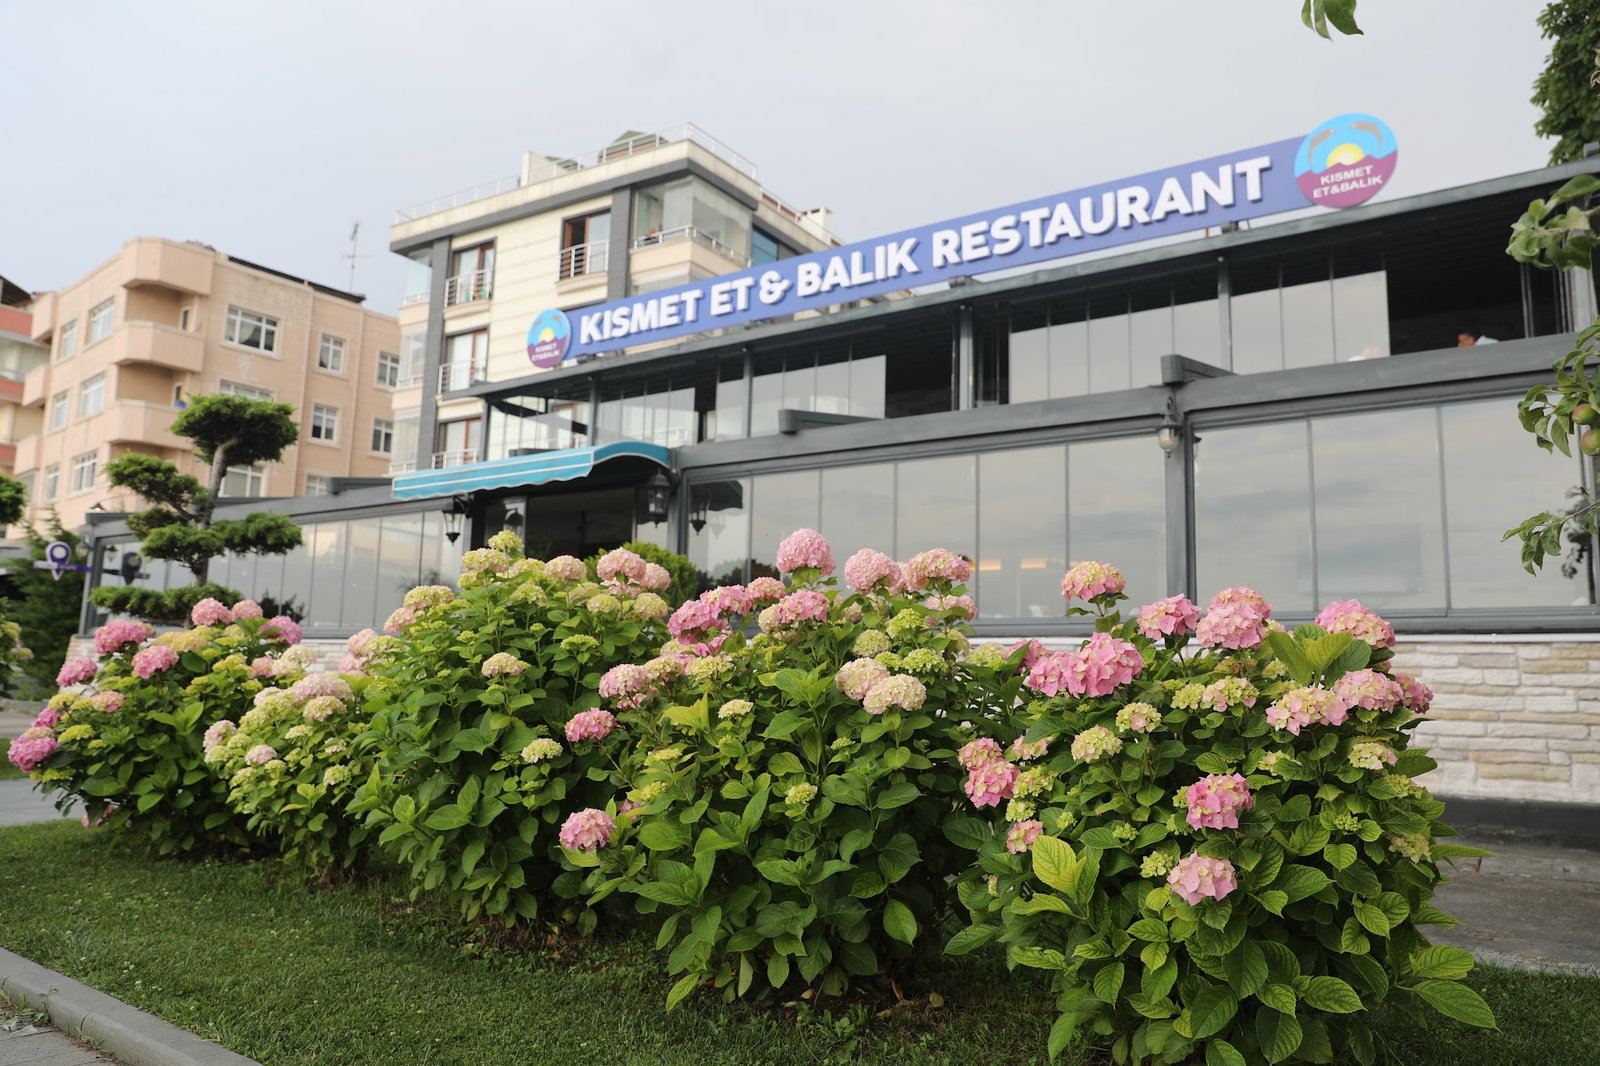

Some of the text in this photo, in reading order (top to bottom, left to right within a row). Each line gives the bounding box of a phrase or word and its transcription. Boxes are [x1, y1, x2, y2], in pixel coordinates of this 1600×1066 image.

[1312, 174, 1384, 198] ET&BALIK
[1320, 164, 1373, 185] KISMET
[580, 156, 1272, 345] KISMET ET & BALIK RESTAURANT
